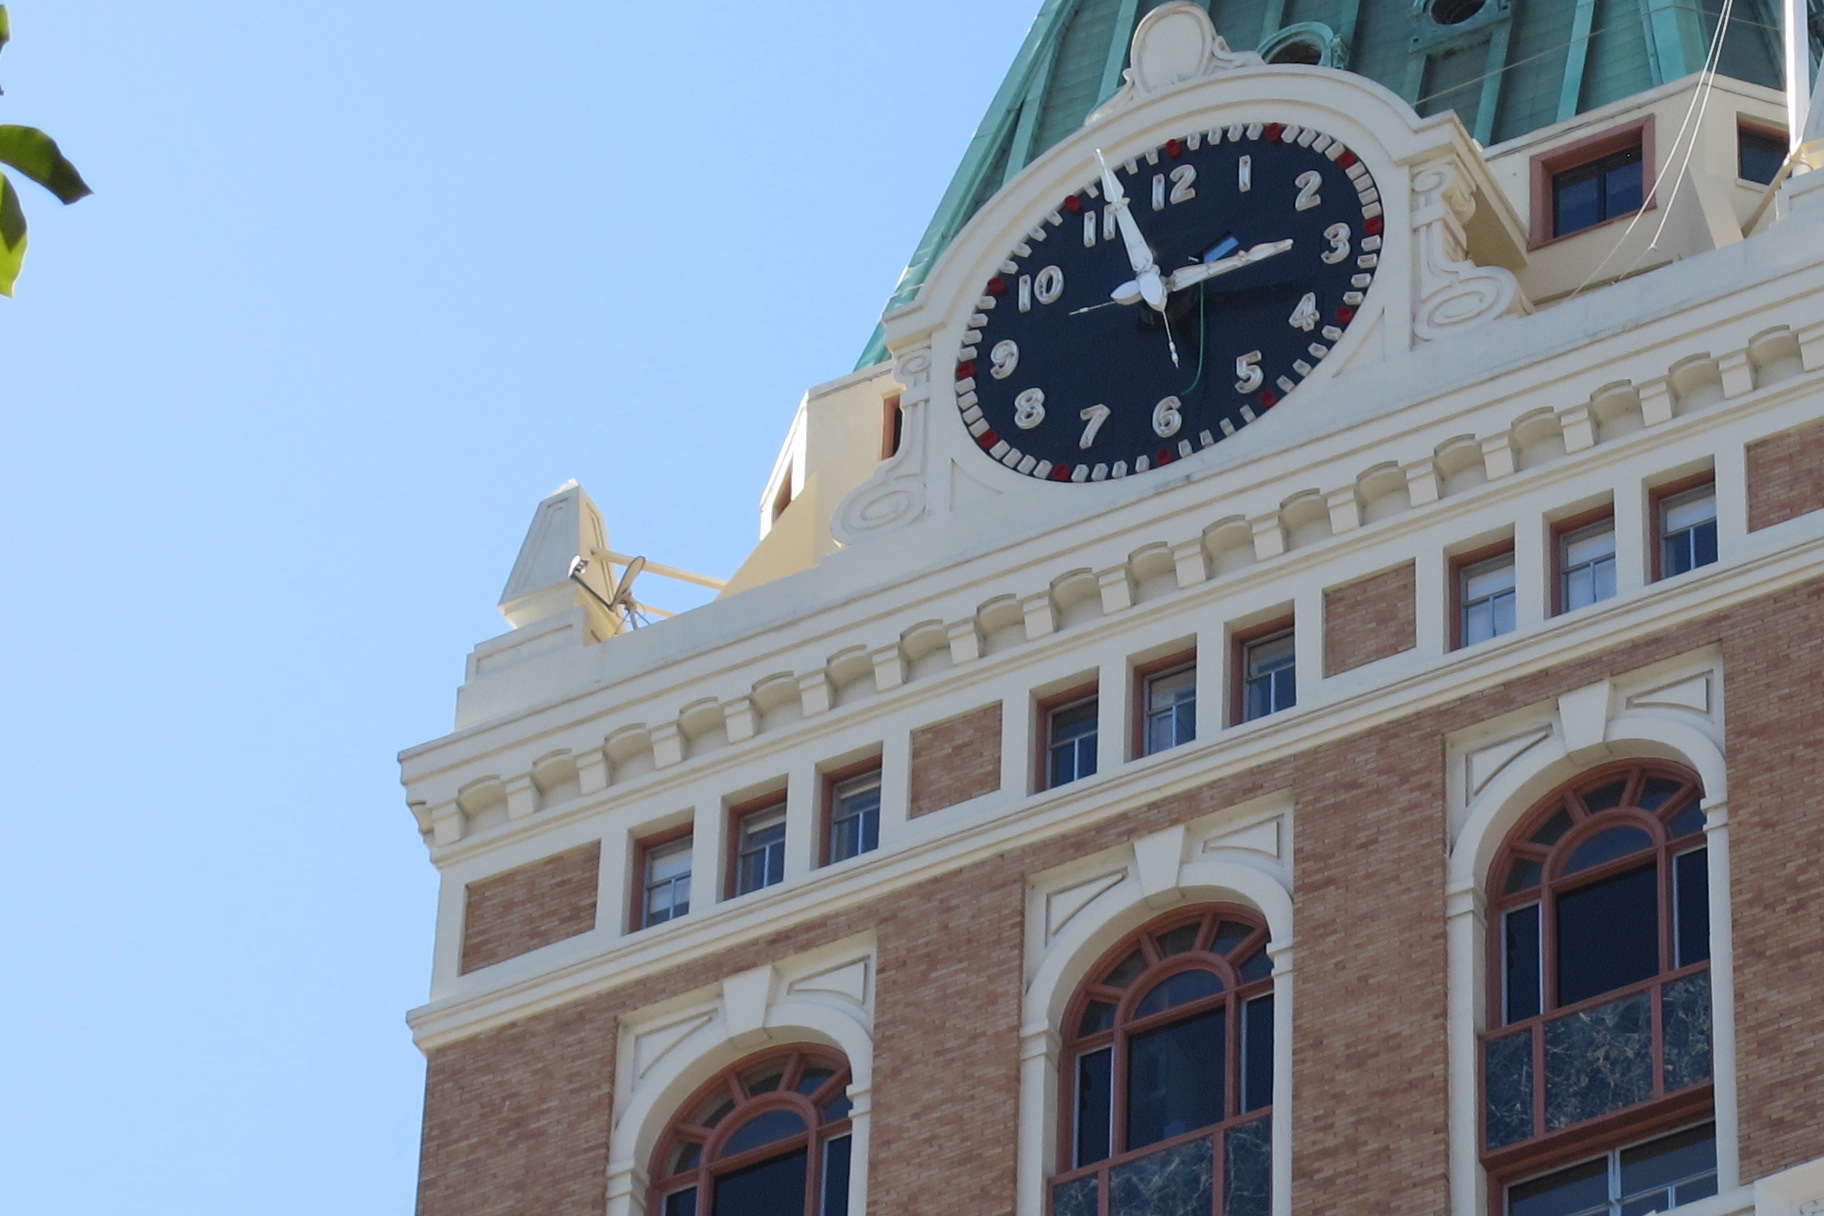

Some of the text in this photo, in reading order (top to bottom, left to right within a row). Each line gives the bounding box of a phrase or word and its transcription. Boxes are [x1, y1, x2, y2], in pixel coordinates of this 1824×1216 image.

[1152, 164, 1198, 212] 12
[1238, 154, 1251, 193] 1
[1294, 170, 1322, 212] 2
[1083, 203, 1116, 248] 11
[1320, 222, 1351, 265] 3
[1018, 264, 1065, 313] 10
[1288, 291, 1321, 332] 4
[989, 339, 1020, 380] 9
[1234, 350, 1264, 394] 5
[1014, 387, 1046, 430] 8
[1079, 403, 1112, 450] 7
[1152, 395, 1183, 438] 6
